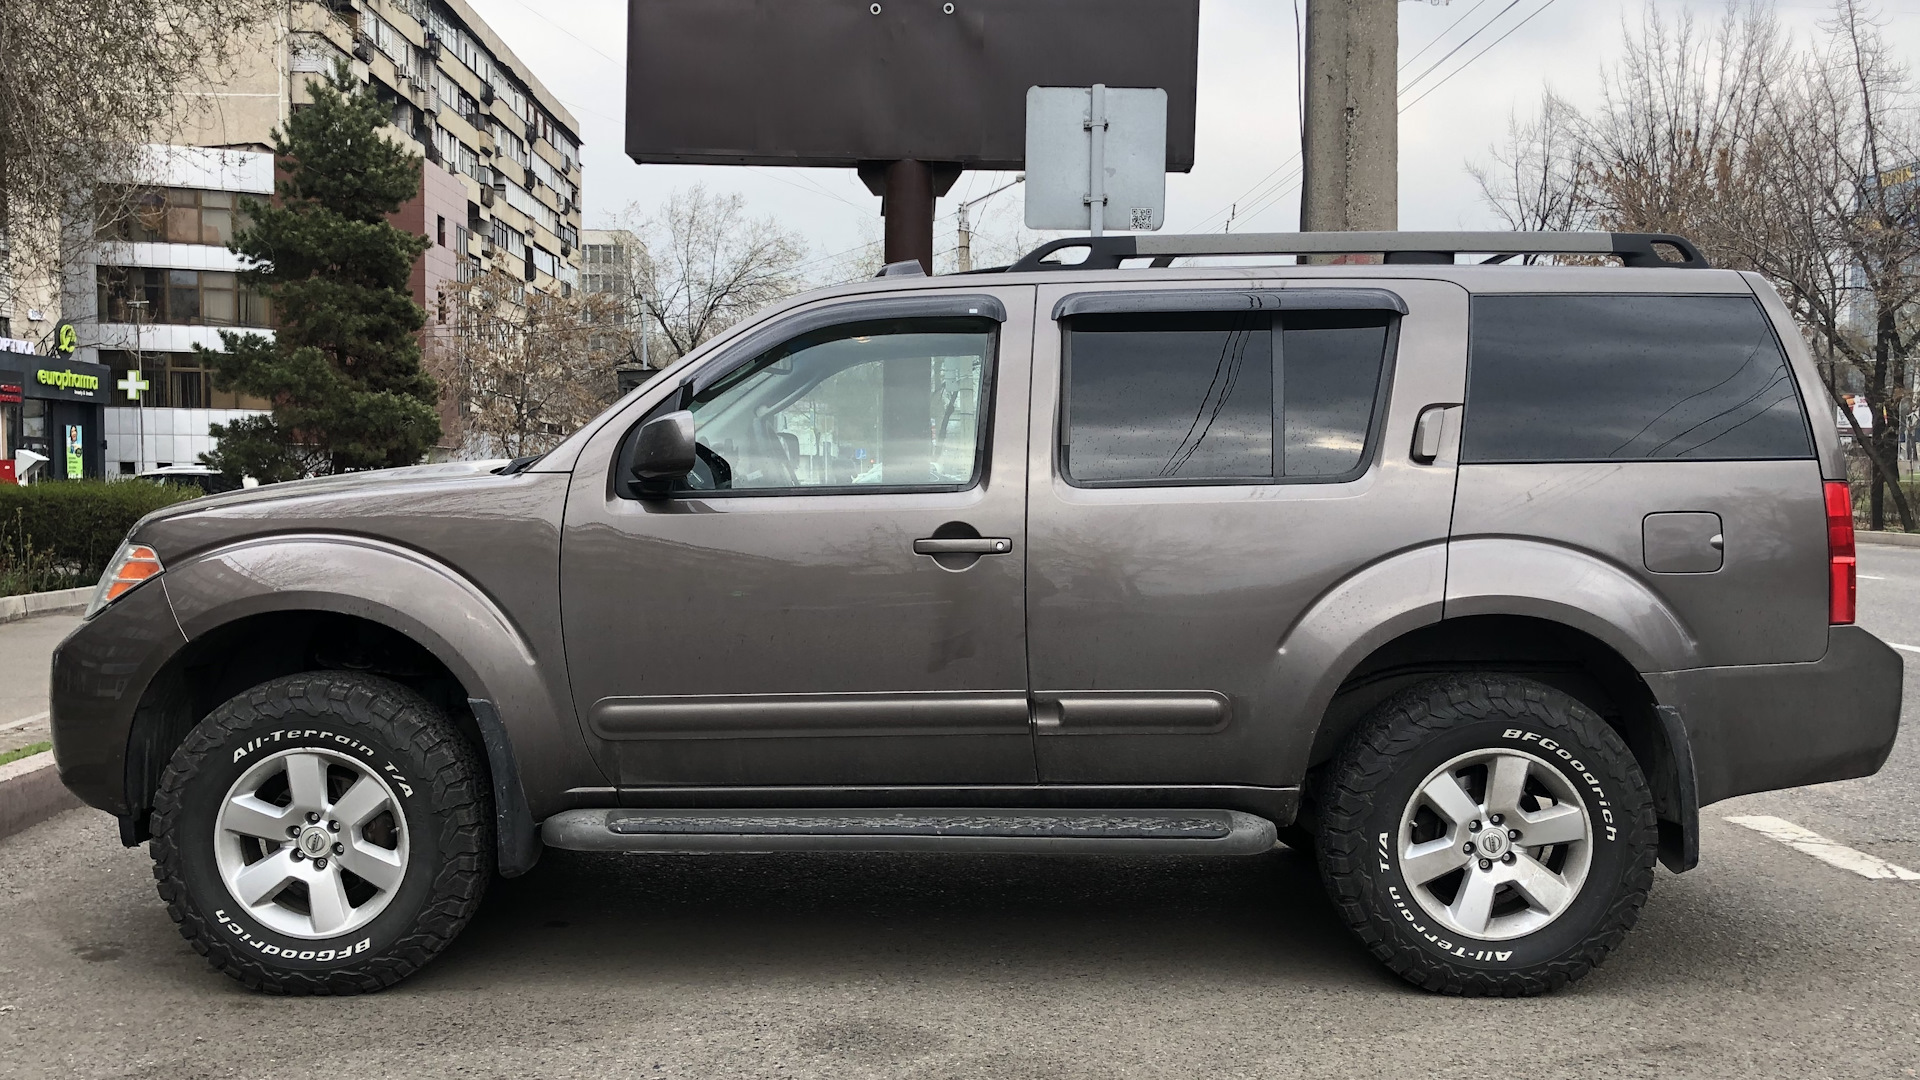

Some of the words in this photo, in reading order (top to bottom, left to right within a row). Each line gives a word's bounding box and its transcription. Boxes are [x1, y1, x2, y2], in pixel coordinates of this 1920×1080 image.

[37, 369, 98, 390] europharma
[232, 729, 375, 764] All-Terrain
[384, 761, 414, 798] T/A
[1501, 728, 1617, 842] BFGoodrich
[1378, 831, 1390, 874] T/A
[214, 908, 371, 962] BFGoodrich
[1388, 886, 1513, 962] All-Terrain
